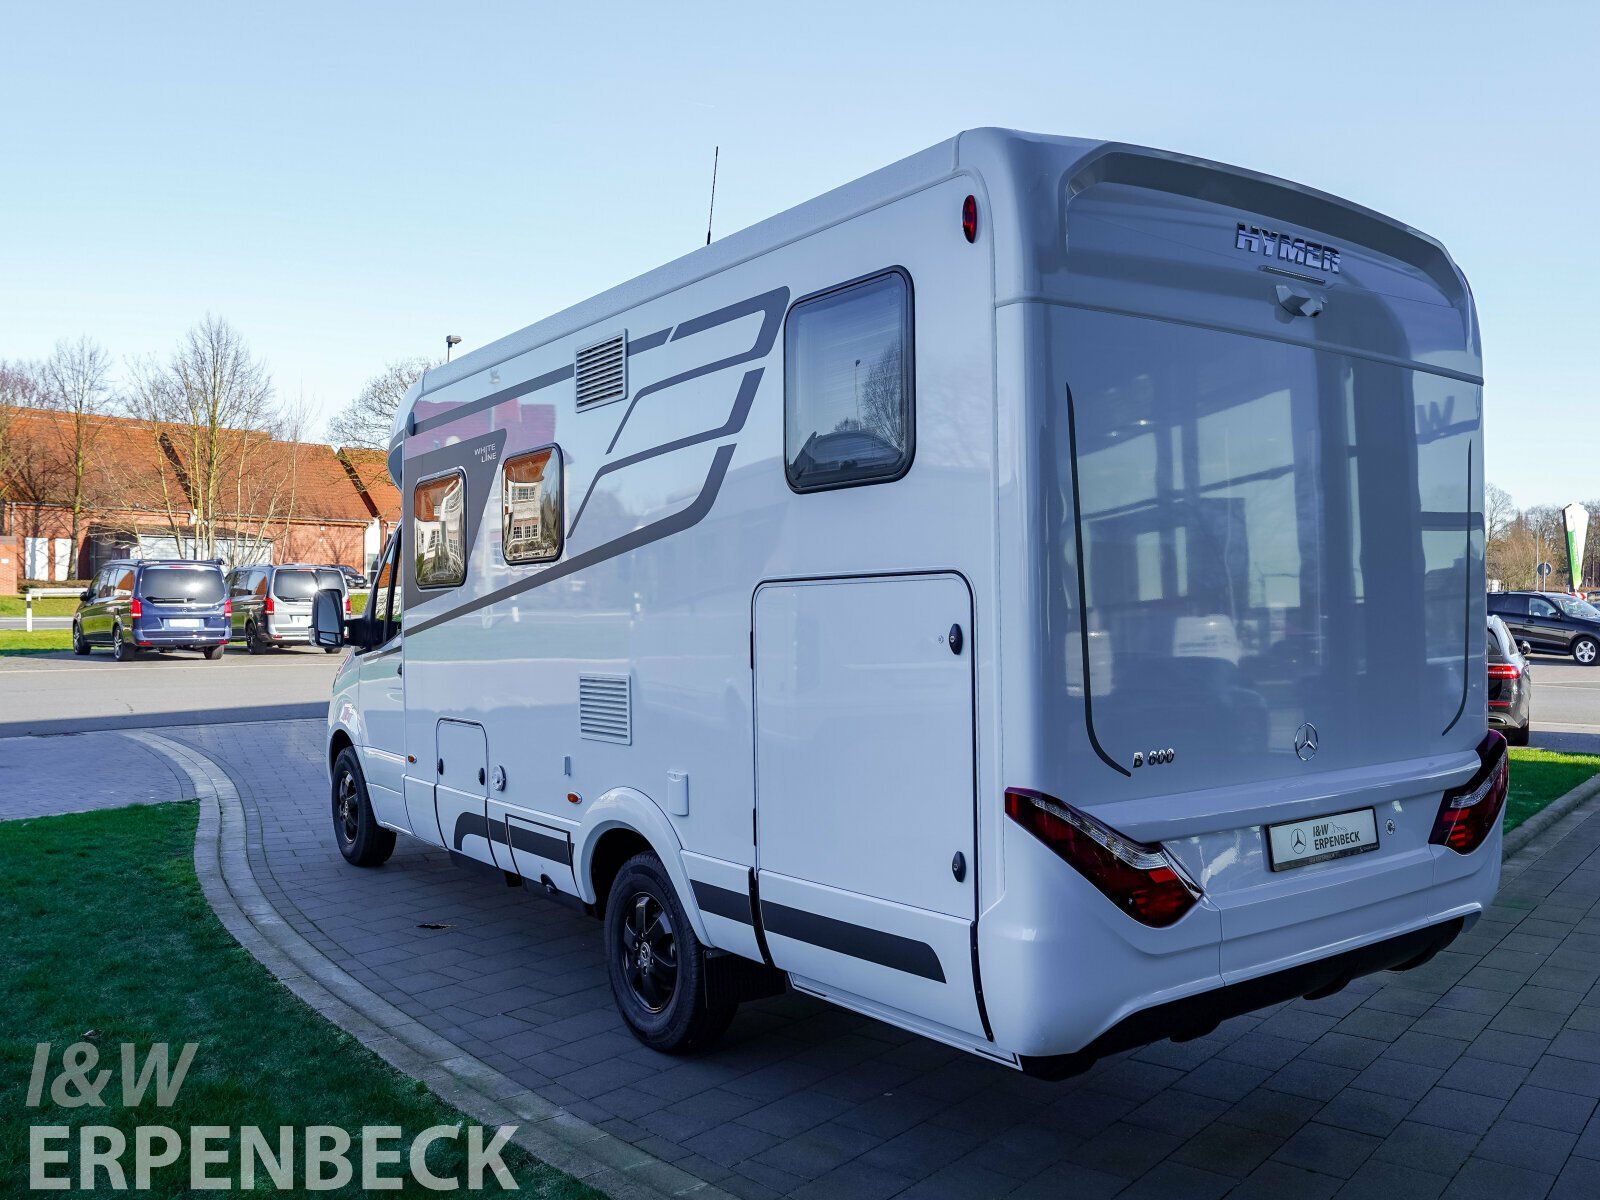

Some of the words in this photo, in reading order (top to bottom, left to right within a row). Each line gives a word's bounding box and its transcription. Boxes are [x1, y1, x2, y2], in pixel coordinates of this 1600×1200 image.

[1236, 222, 1341, 273] HYMER
[474, 443, 496, 456] WHITE
[481, 452, 497, 463] LINE
[1133, 751, 1144, 768] B
[1147, 748, 1175, 766] 600
[1312, 823, 1329, 837] I&W
[1314, 831, 1361, 850] ERPENBECK
